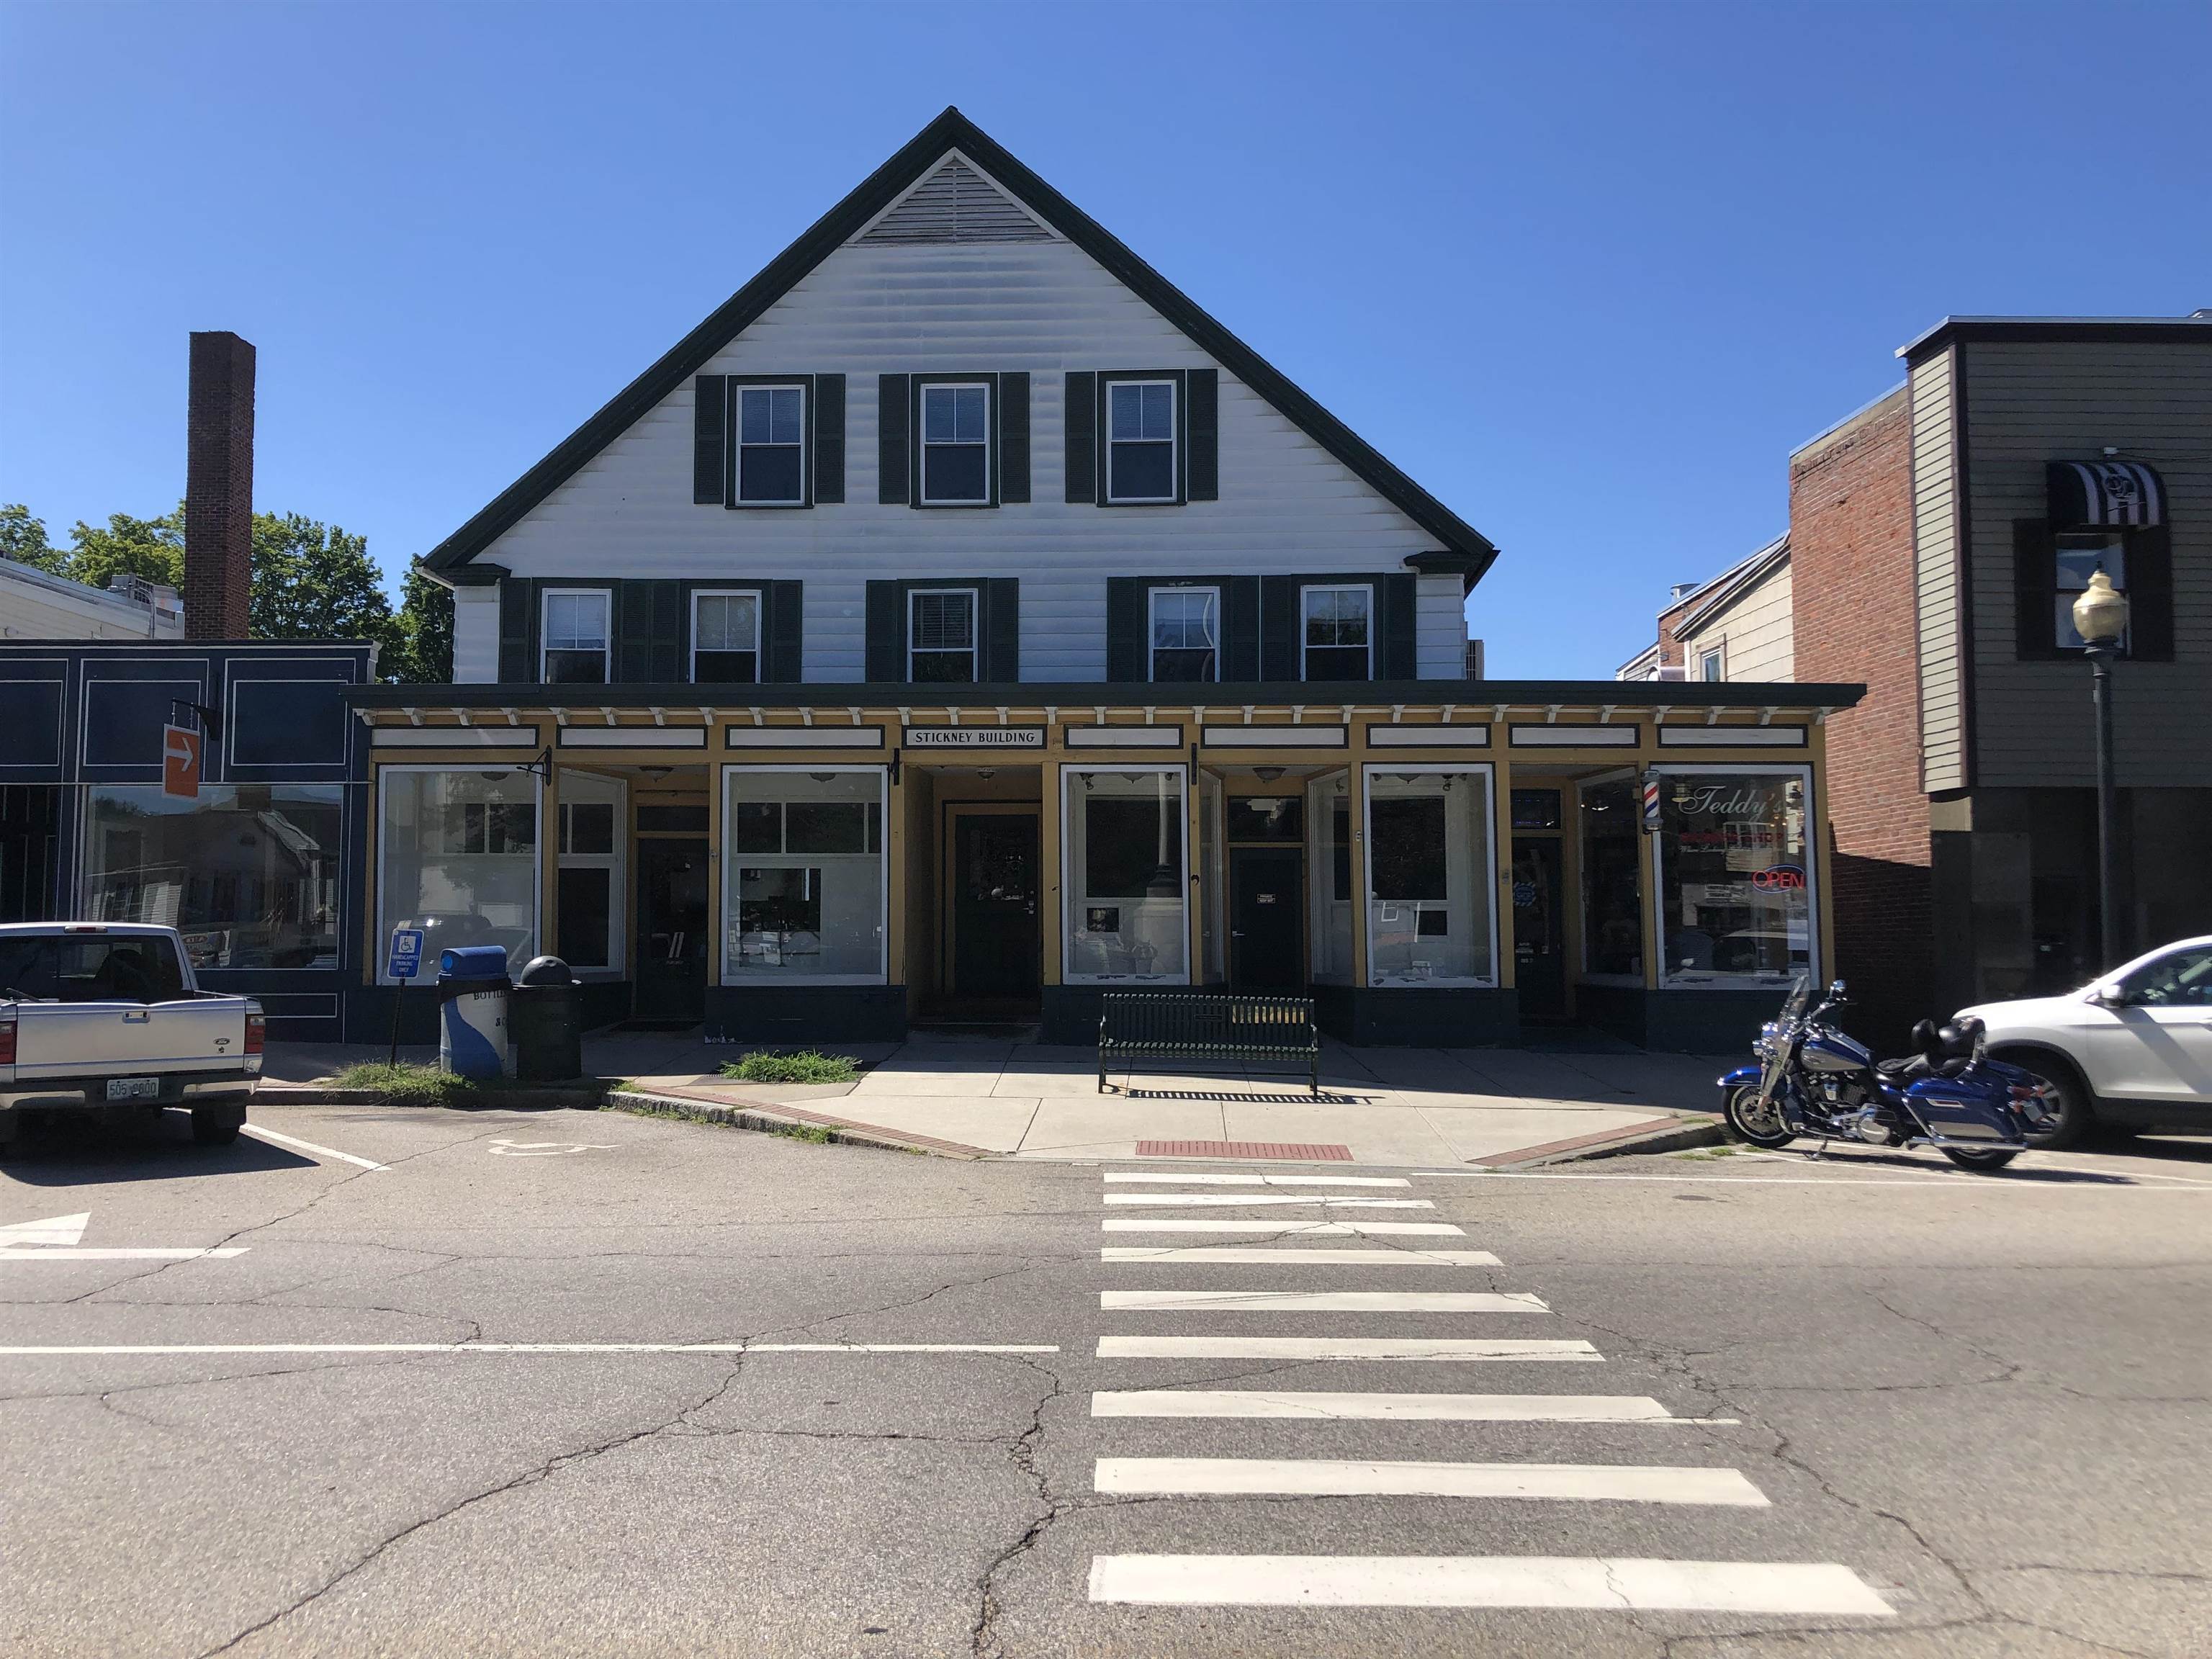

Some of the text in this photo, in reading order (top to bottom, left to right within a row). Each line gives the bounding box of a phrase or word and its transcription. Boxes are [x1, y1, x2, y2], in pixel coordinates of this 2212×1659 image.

[915, 732, 1035, 743] STICKNEY BUILDING
[1678, 786, 1784, 823] Teddy's
[1753, 870, 1806, 889] OPEN
[109, 1083, 127, 1095] 505
